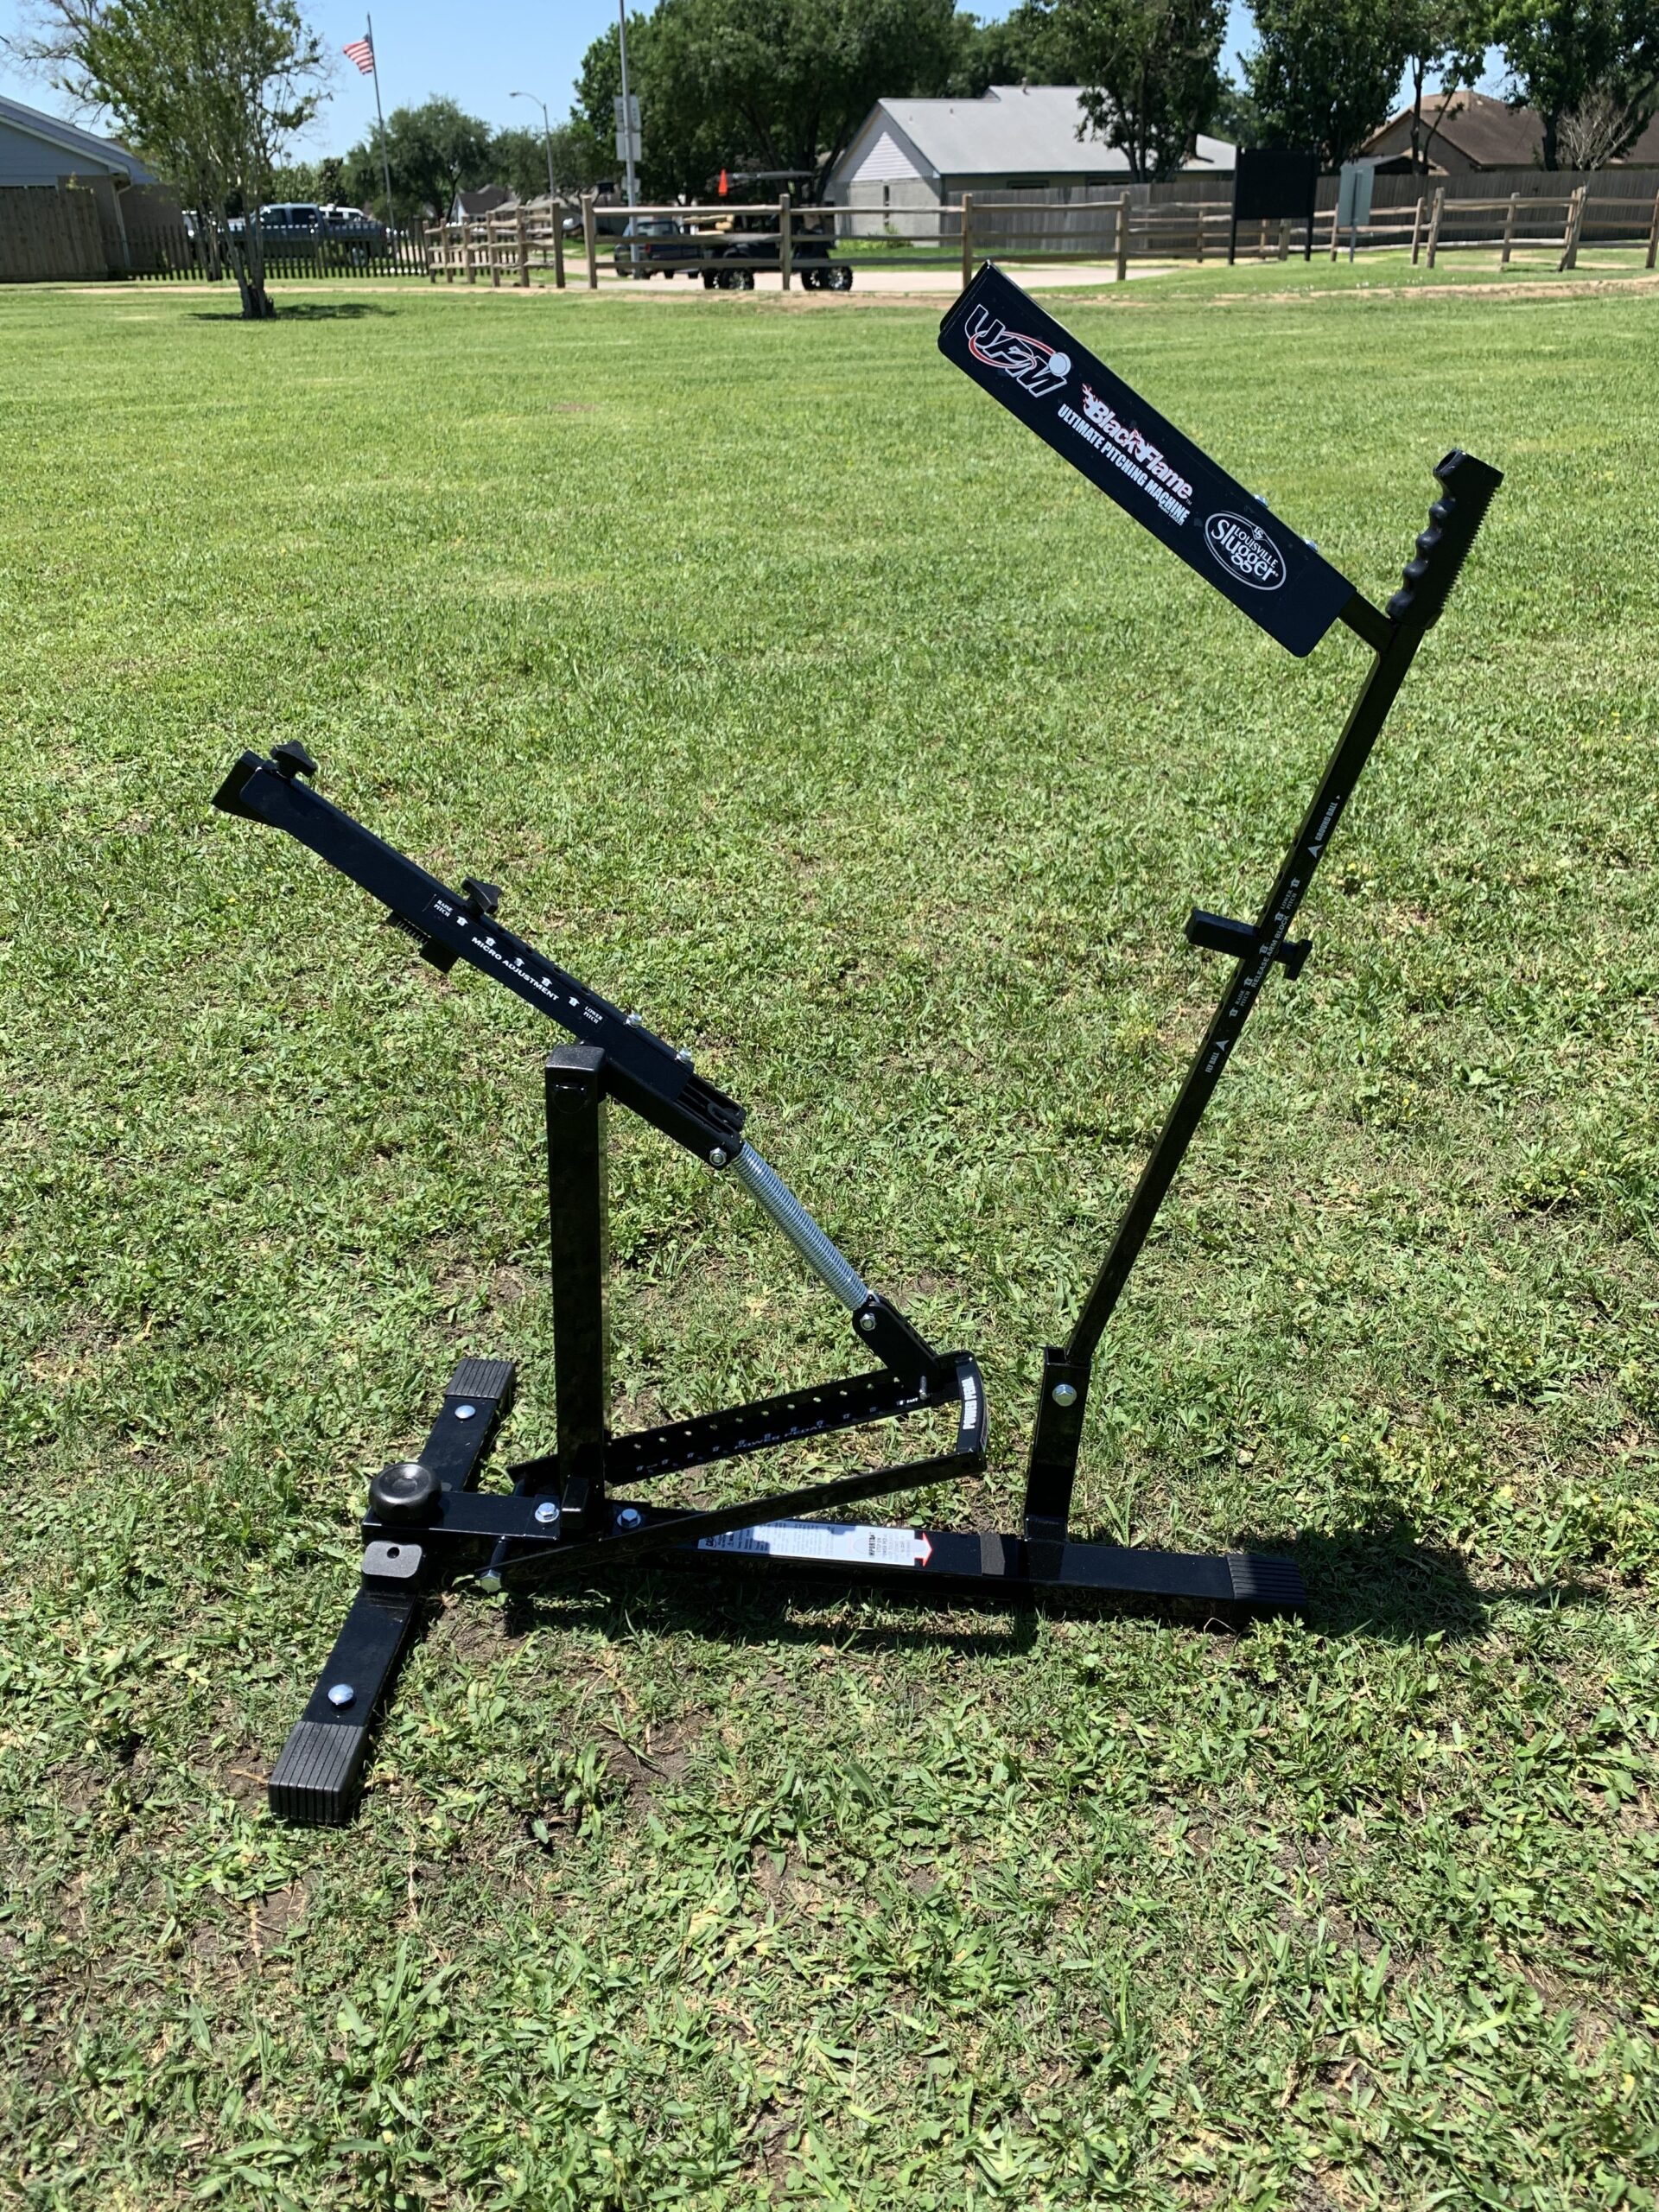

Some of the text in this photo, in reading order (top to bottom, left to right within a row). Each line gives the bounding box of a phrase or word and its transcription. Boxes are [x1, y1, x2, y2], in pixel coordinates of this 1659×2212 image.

[1057, 403, 1191, 522] ULTIMATE PITCHING MACHINE
[1211, 518, 1276, 582] Slugger
[1234, 527, 1278, 569] LOUISVILLE
[1314, 802, 1338, 842] GROUND BALL
[434, 904, 450, 917] PITCH
[436, 899, 454, 912] RAISE
[1280, 889, 1294, 910] LOWER
[1286, 893, 1298, 911] PITCH
[1250, 915, 1290, 988] RELEASE ARM BLOCK
[471, 937, 560, 1001] MICRO ADJUSTMENT
[582, 1011, 599, 1024] PITCH
[584, 1006, 603, 1021] LOWER
[963, 1400, 977, 1430] POWER
